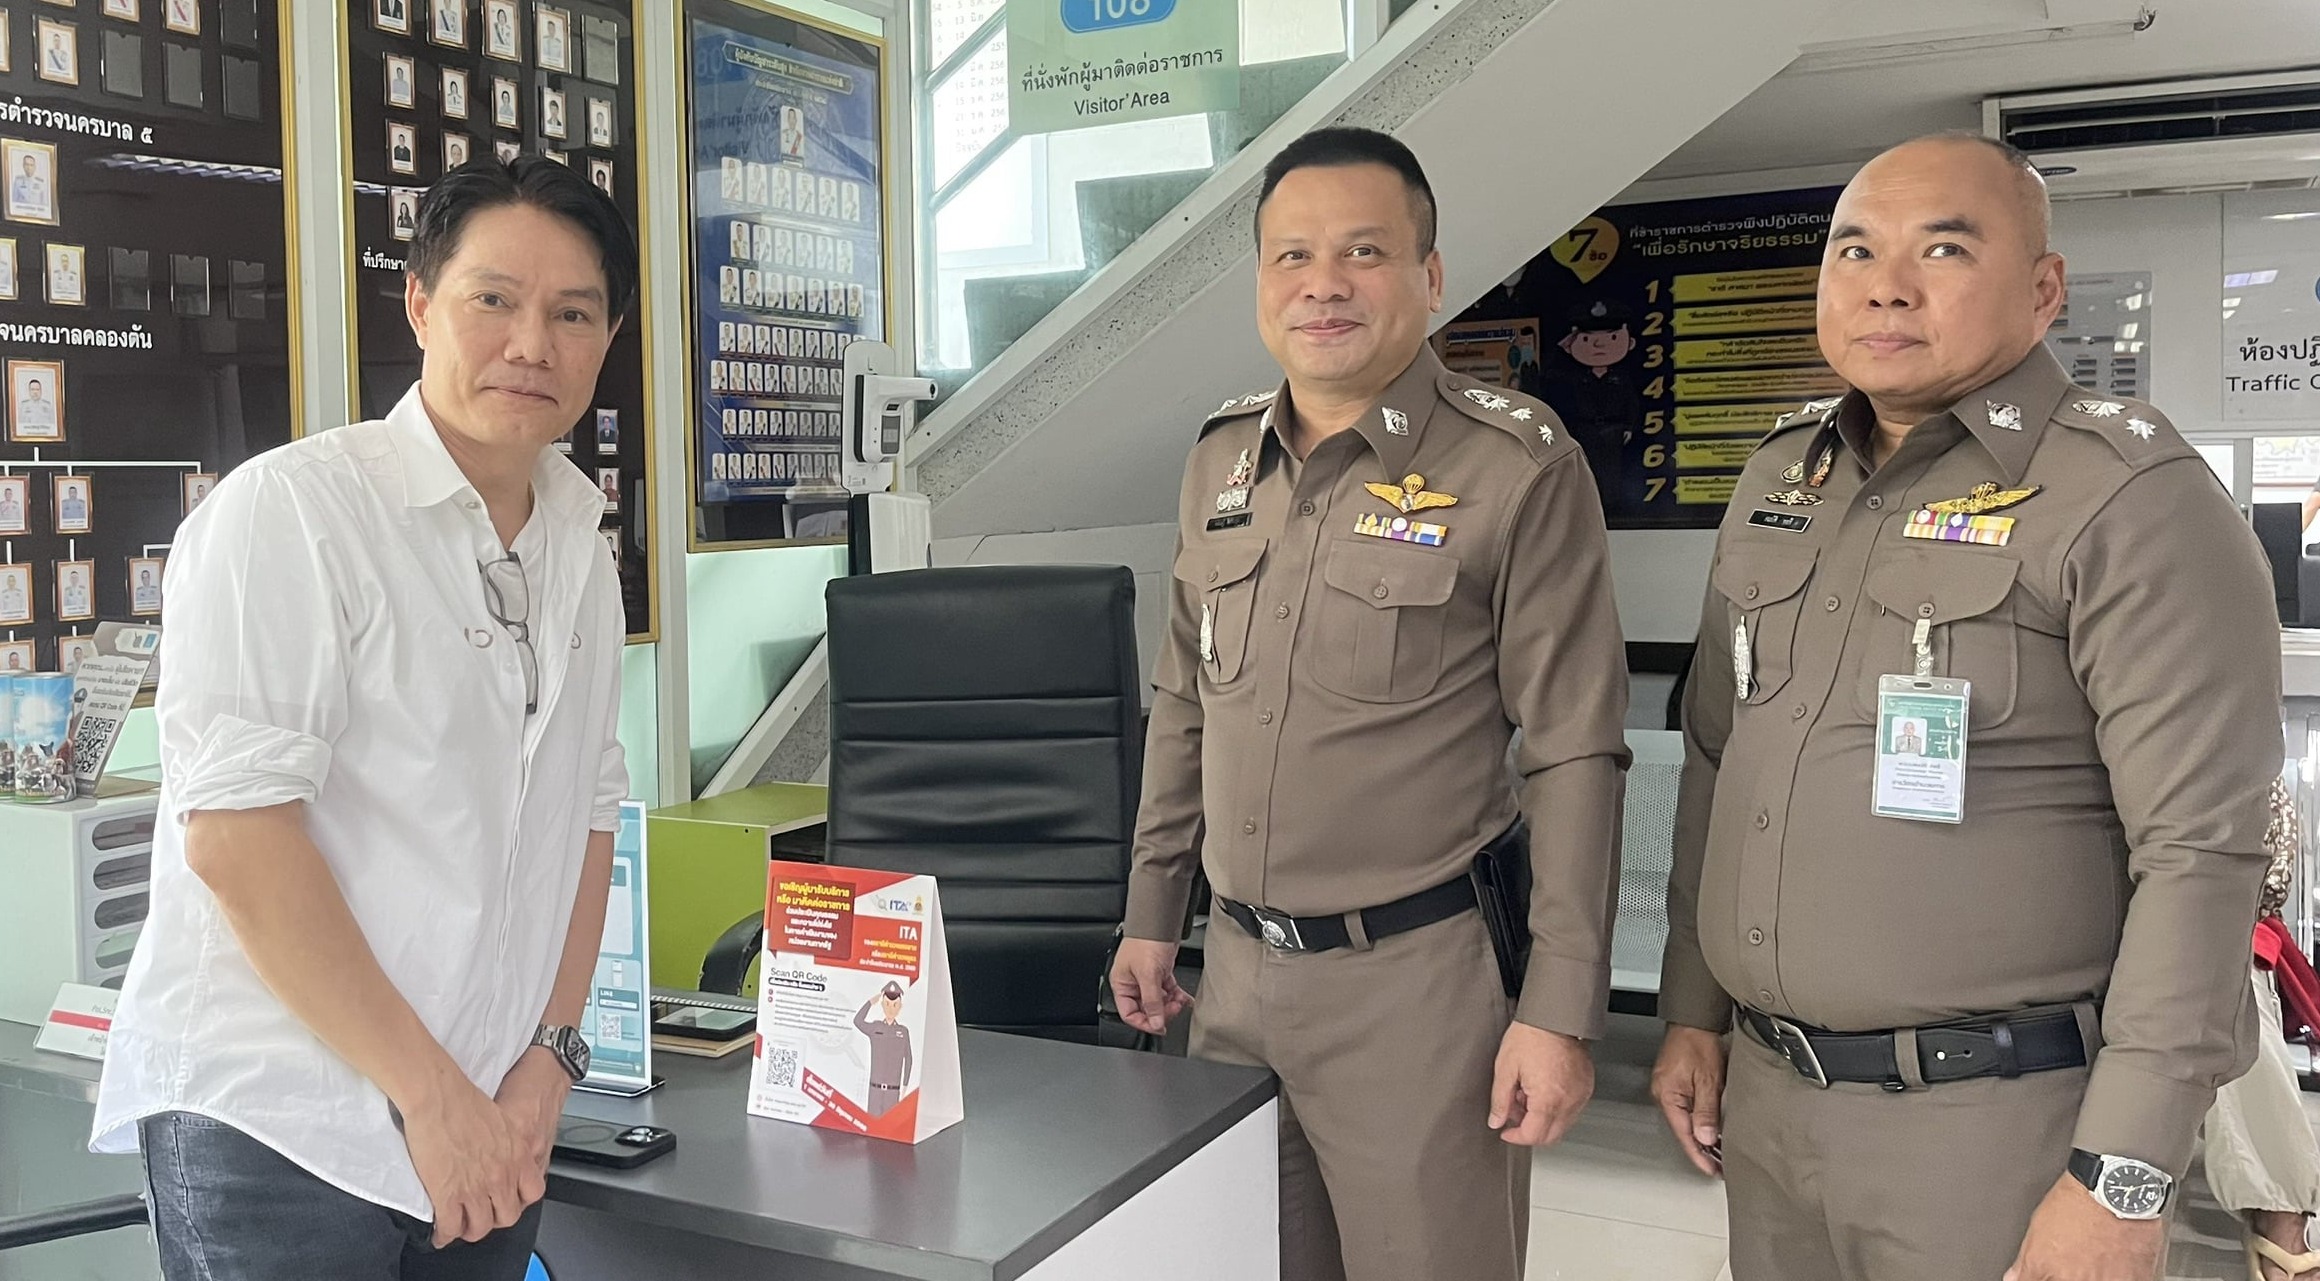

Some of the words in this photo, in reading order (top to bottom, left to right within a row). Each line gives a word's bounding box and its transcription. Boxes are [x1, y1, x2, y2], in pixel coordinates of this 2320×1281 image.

[1021, 48, 1224, 92] ที่นั่งพักผู้มาติดต่อราชการ
[1568, 228, 1598, 262] 7
[1645, 280, 1660, 304] 1
[0, 323, 153, 349] จนครบาลคลองตัน
[1642, 312, 1664, 336] 2
[1642, 345, 1664, 369] 3
[1642, 376, 1664, 399] 4
[2226, 374, 2300, 392] Traffic
[1643, 411, 1665, 434] 5
[1643, 444, 1665, 468] 6
[1644, 478, 1666, 501] 7
[899, 925, 918, 941] ITA
[770, 967, 791, 979] Scan
[792, 969, 805, 980] QR
[806, 971, 827, 983] Code
